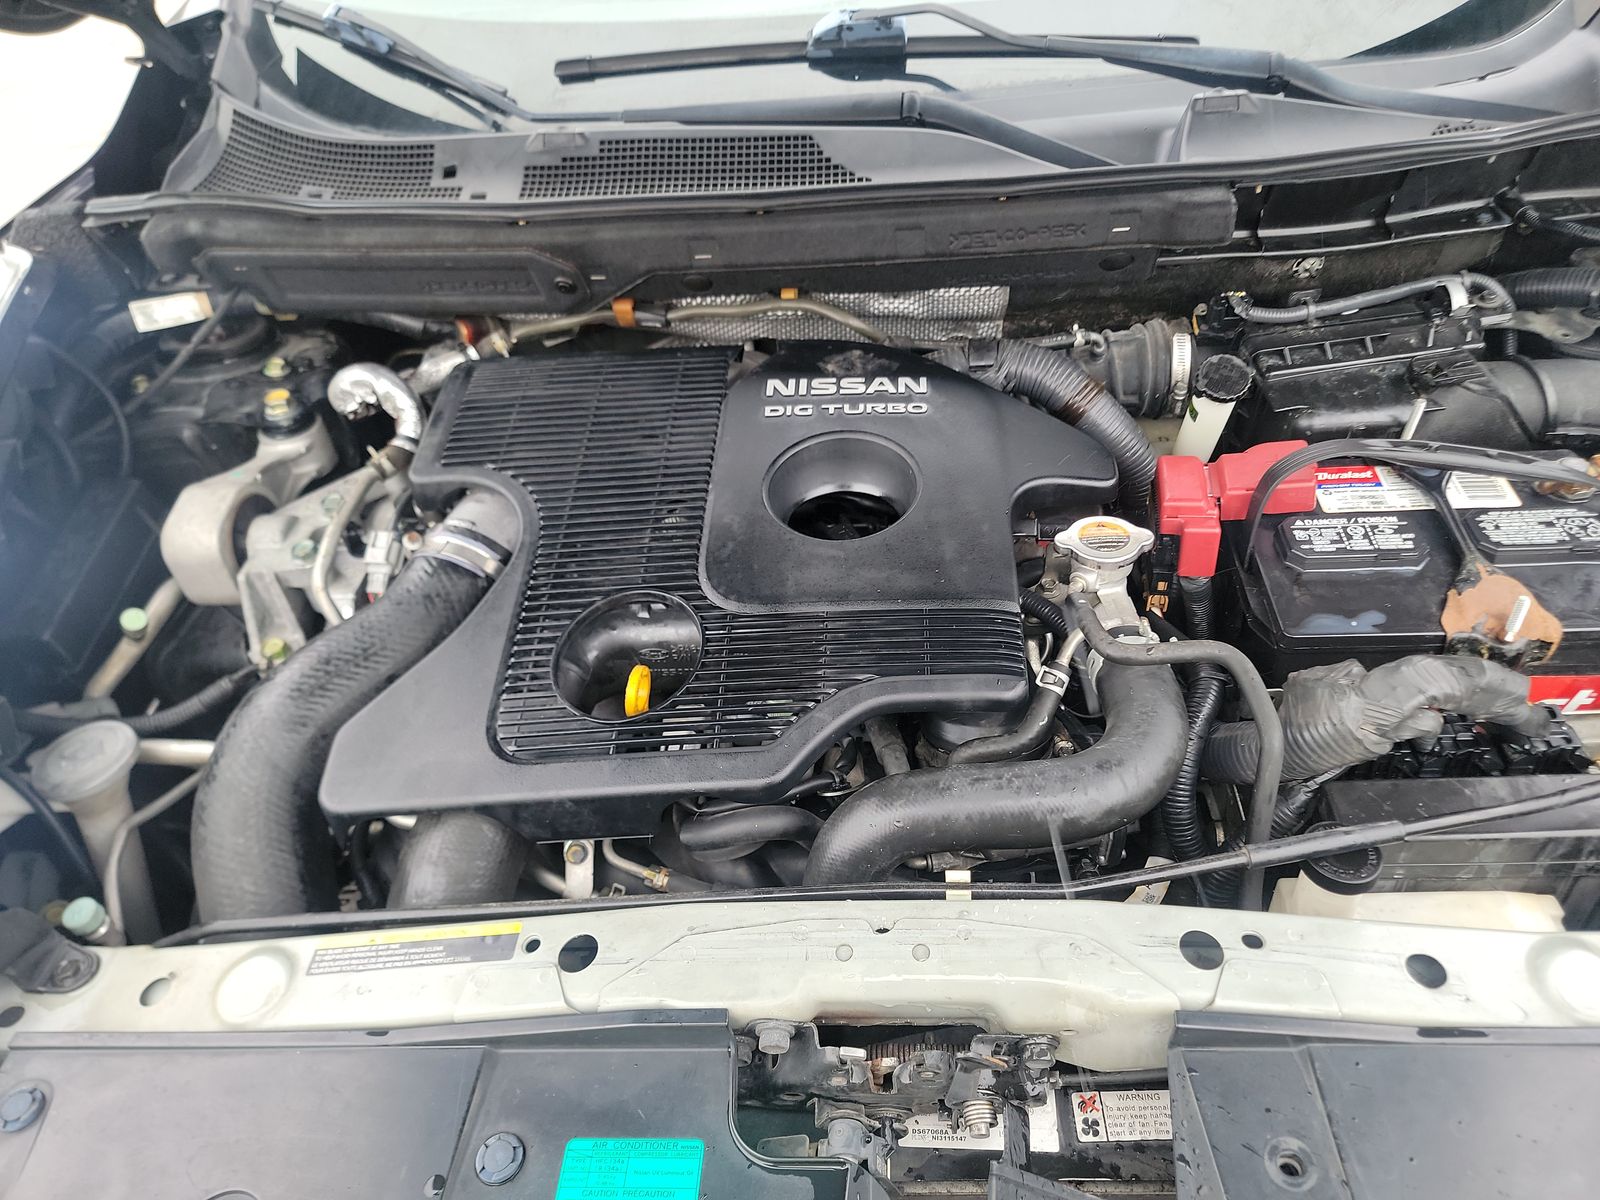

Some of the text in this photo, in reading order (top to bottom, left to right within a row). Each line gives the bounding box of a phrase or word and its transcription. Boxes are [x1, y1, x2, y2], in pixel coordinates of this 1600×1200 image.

[766, 377, 928, 396] NISSAN
[764, 402, 928, 417] DIG TURBO
[1314, 471, 1374, 480] Duralast
[1357, 516, 1398, 524] POISON
[1116, 1093, 1161, 1101] WARNING
[1138, 1104, 1169, 1112] personal
[1109, 1129, 1126, 1137] start
[592, 1141, 608, 1149] AIR
[613, 1141, 679, 1150] CONDITIONER
[582, 1190, 618, 1198] CAUTION
